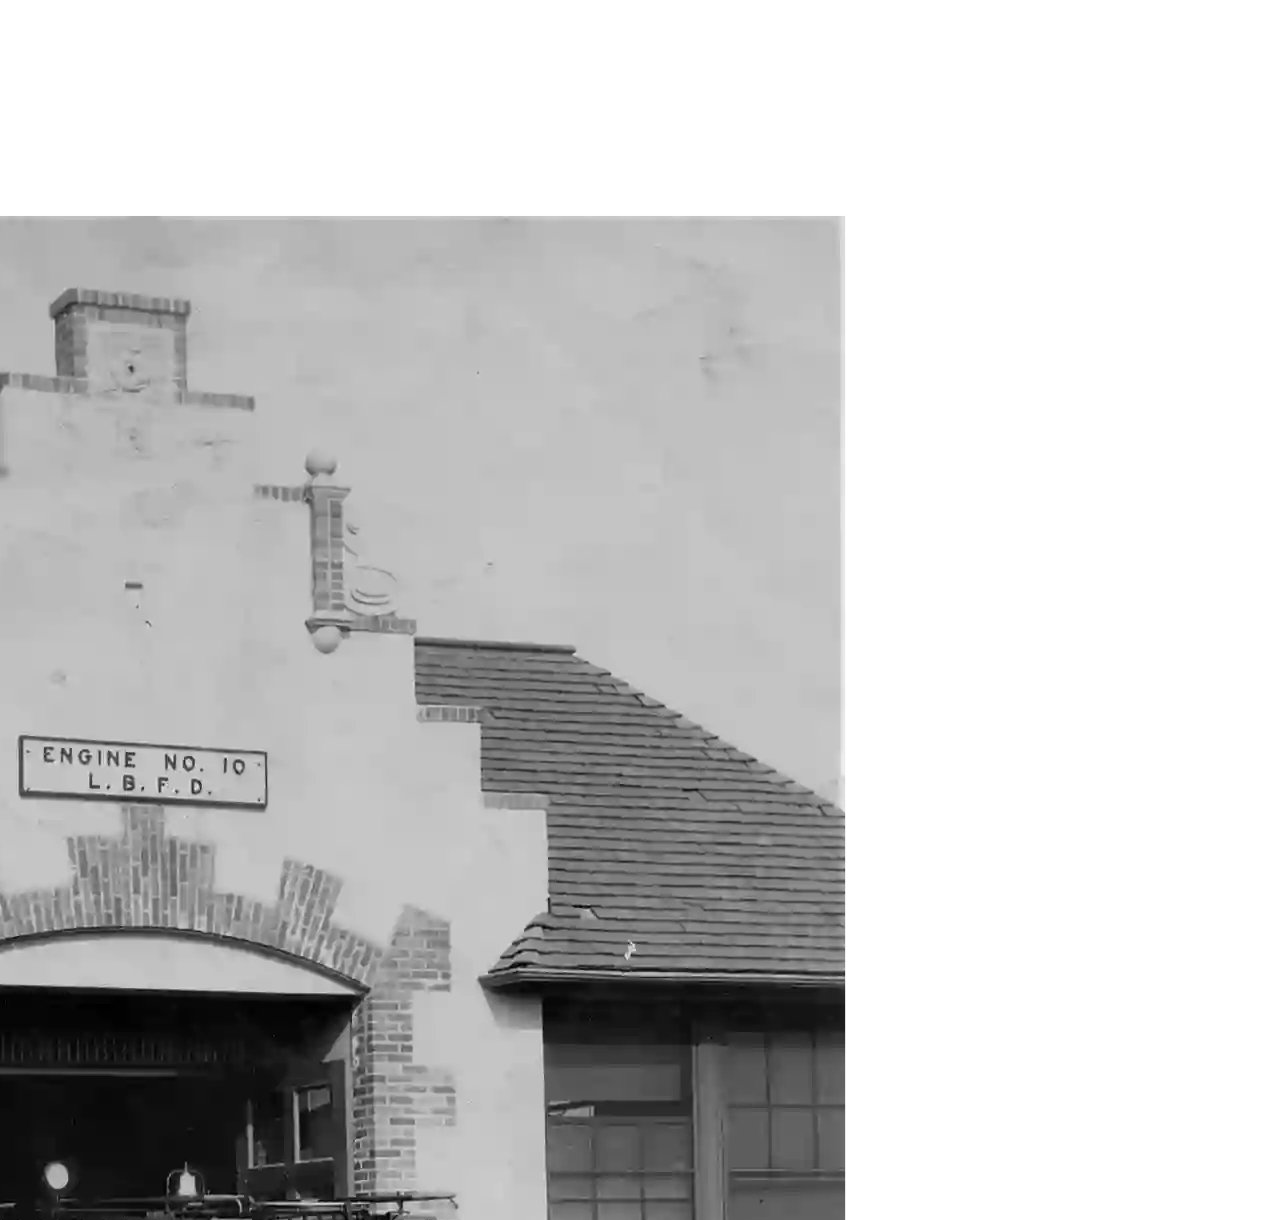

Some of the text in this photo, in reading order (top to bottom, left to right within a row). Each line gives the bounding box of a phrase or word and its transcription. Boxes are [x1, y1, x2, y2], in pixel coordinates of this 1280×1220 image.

[43, 747, 246, 775] ENGINE NO. 10
